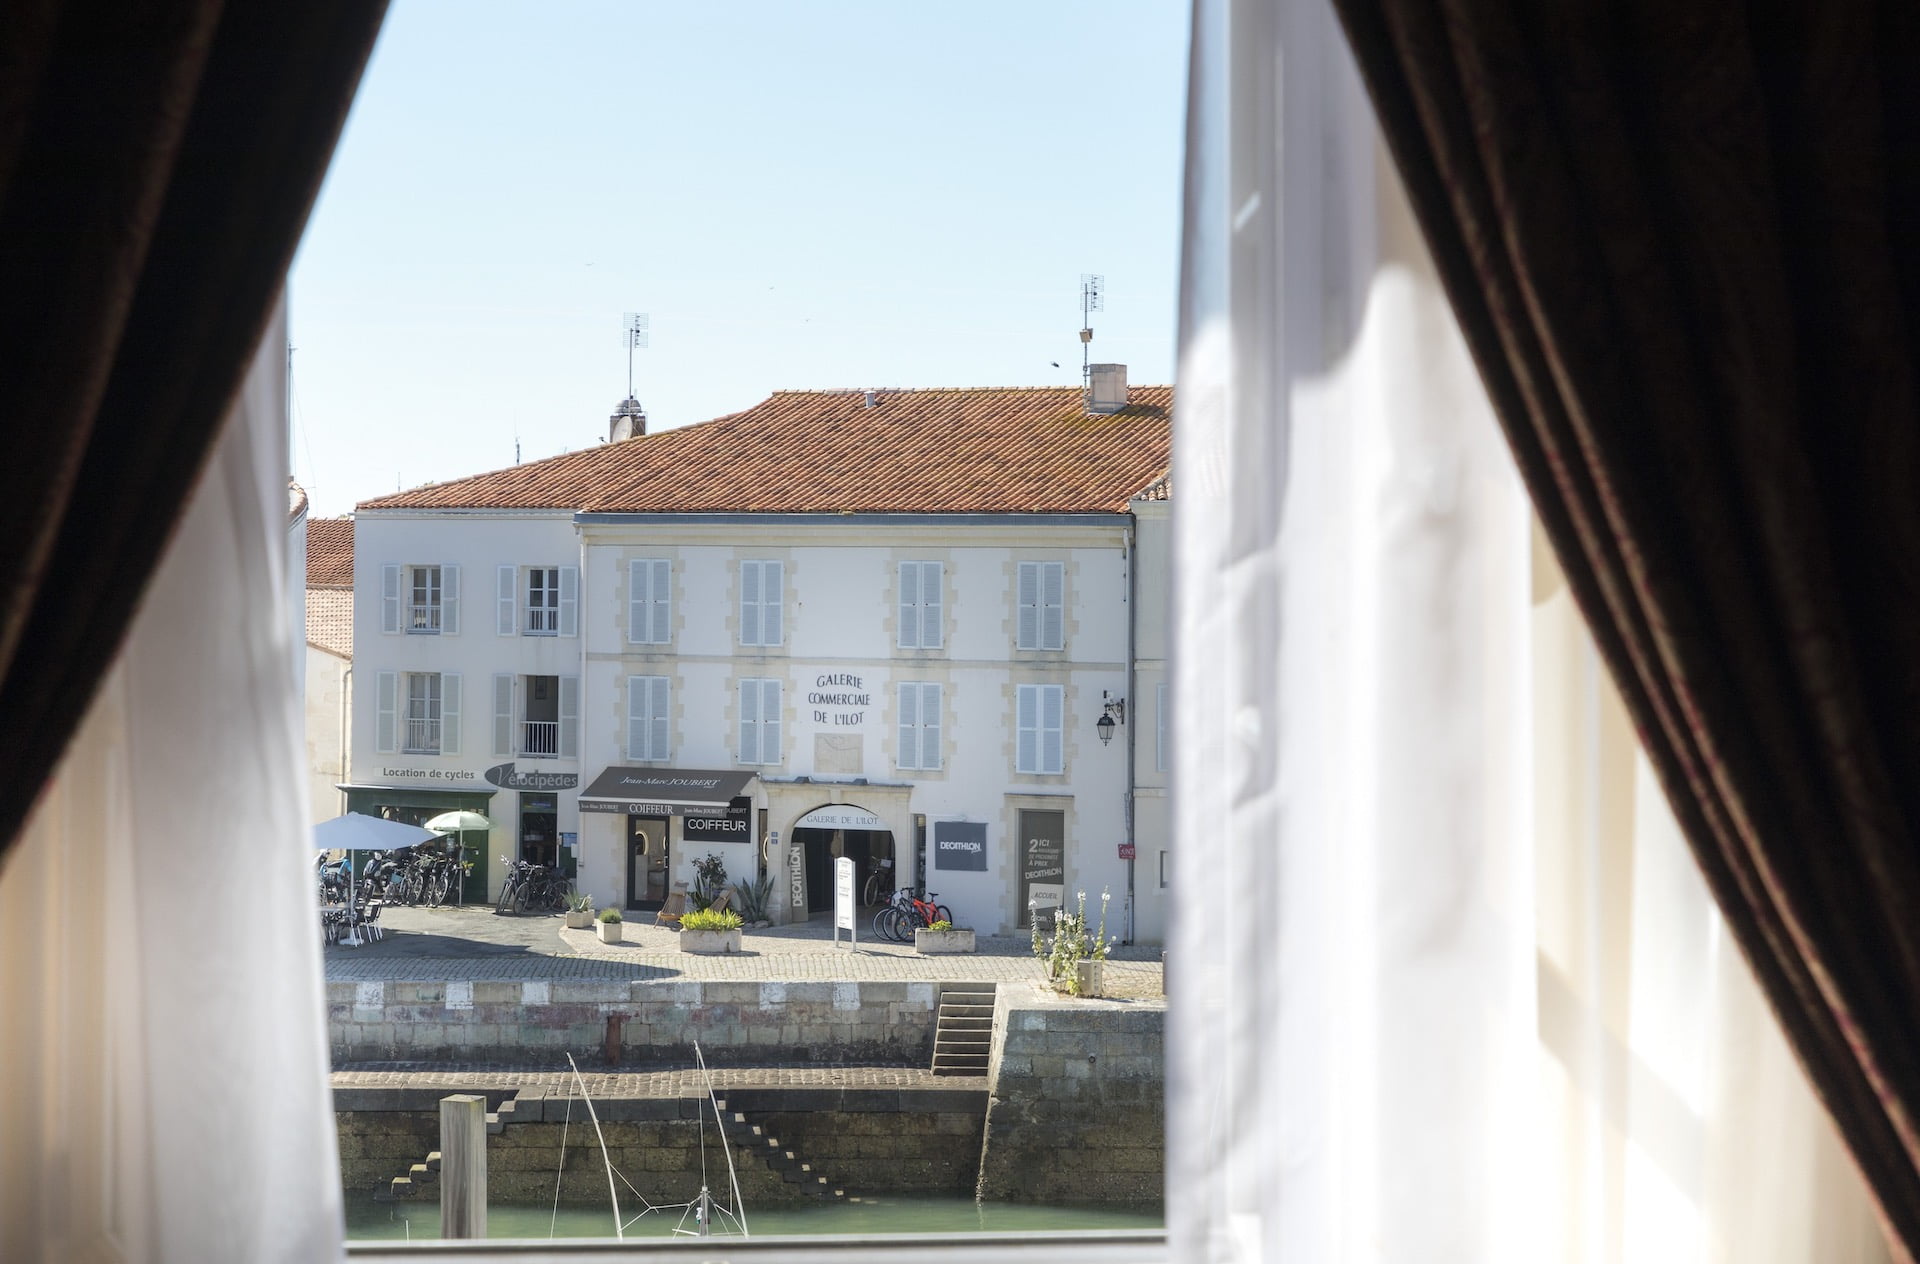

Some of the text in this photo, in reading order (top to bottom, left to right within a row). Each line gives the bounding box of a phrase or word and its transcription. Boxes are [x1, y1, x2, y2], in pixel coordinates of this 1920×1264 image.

[816, 674, 863, 689] GALERIE
[808, 692, 871, 705] COMMERCIALE
[814, 710, 864, 726] DE L'ILOT
[383, 767, 475, 781] Location de cycles
[666, 778, 721, 786] JOUBERT
[629, 803, 674, 815] COIFFEUR
[688, 818, 747, 832] COIFFEUR
[806, 815, 837, 824] GALERIE
[841, 816, 853, 824] DE
[940, 841, 981, 851] DECATHLON
[1028, 838, 1038, 853] 2
[1039, 838, 1050, 847] ICI
[791, 846, 803, 907] DECATHLON
[1025, 866, 1063, 879] DECATHLON
